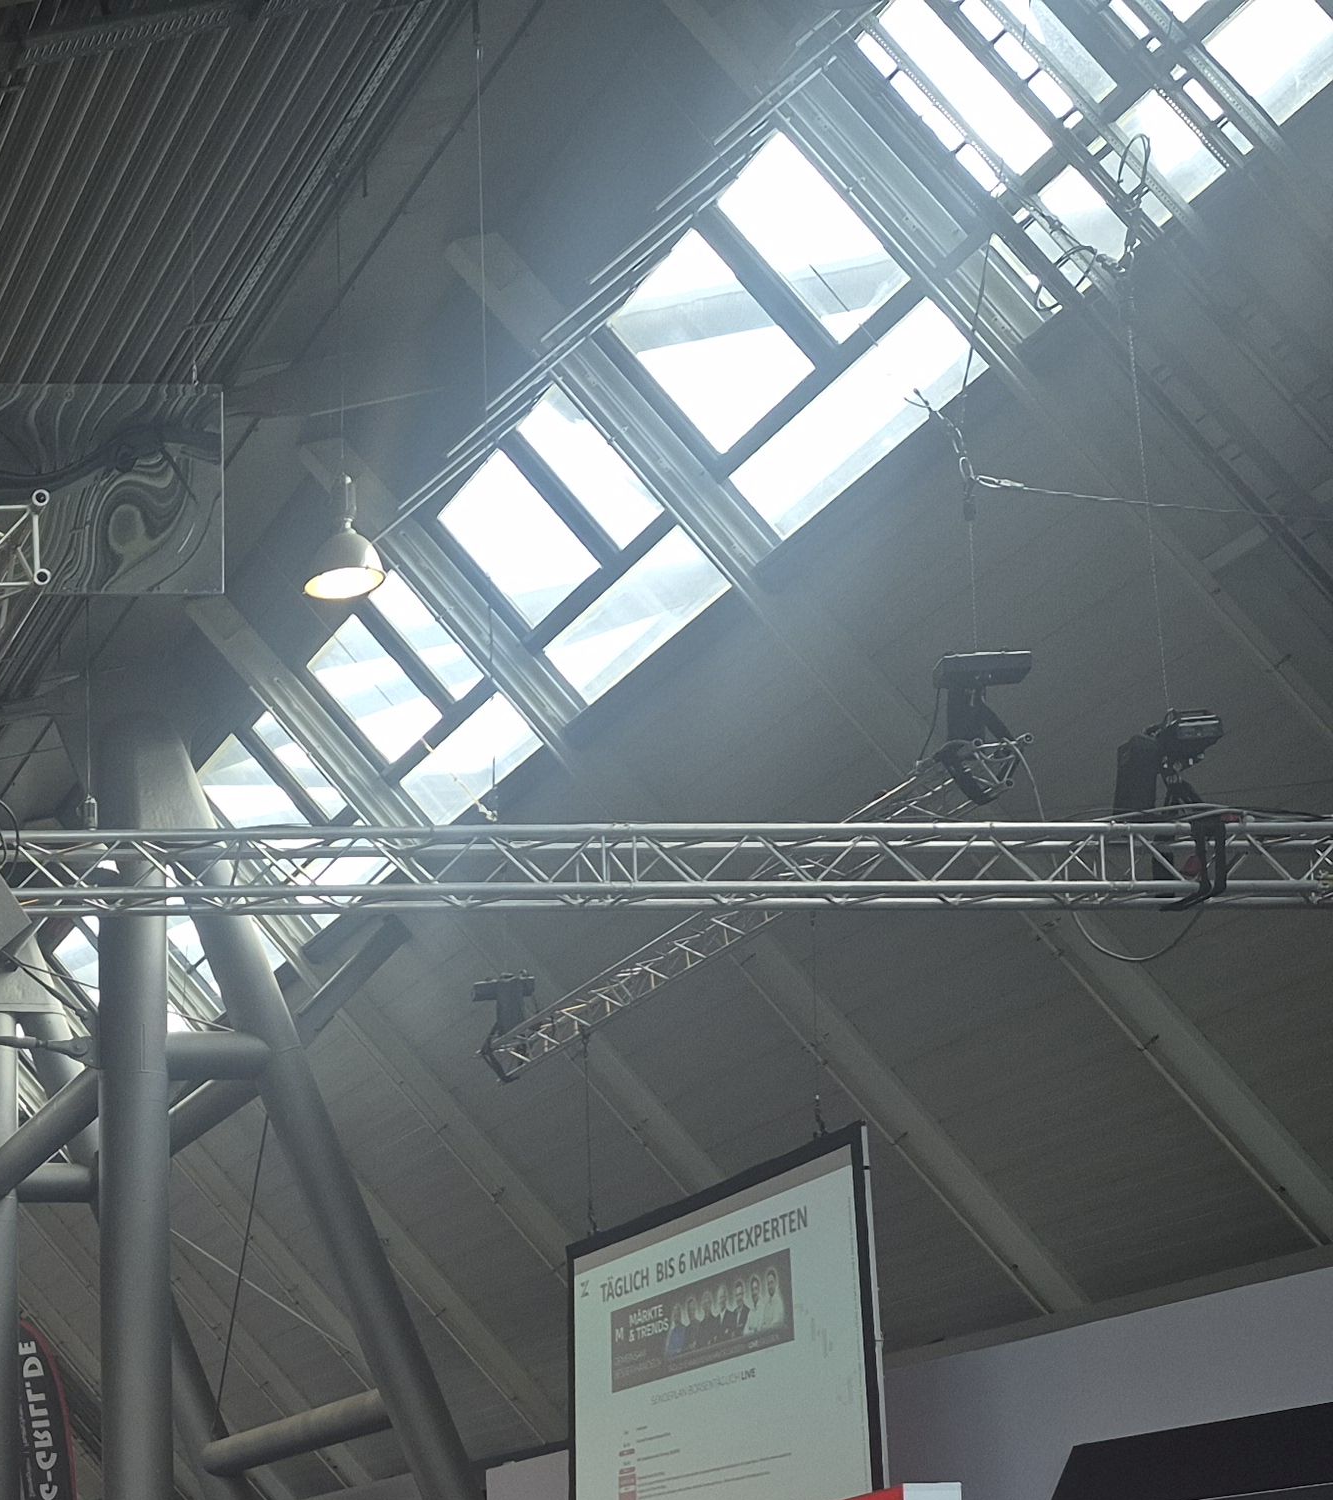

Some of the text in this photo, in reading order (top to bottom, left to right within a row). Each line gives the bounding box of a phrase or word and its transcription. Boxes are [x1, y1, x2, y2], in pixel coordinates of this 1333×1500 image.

[600, 1206, 808, 1303] TÄGLICH BIS 6 MARKTEXPERTEN
[629, 1303, 664, 1326] MÄRKTE
[637, 1318, 669, 1339] TRENDS
